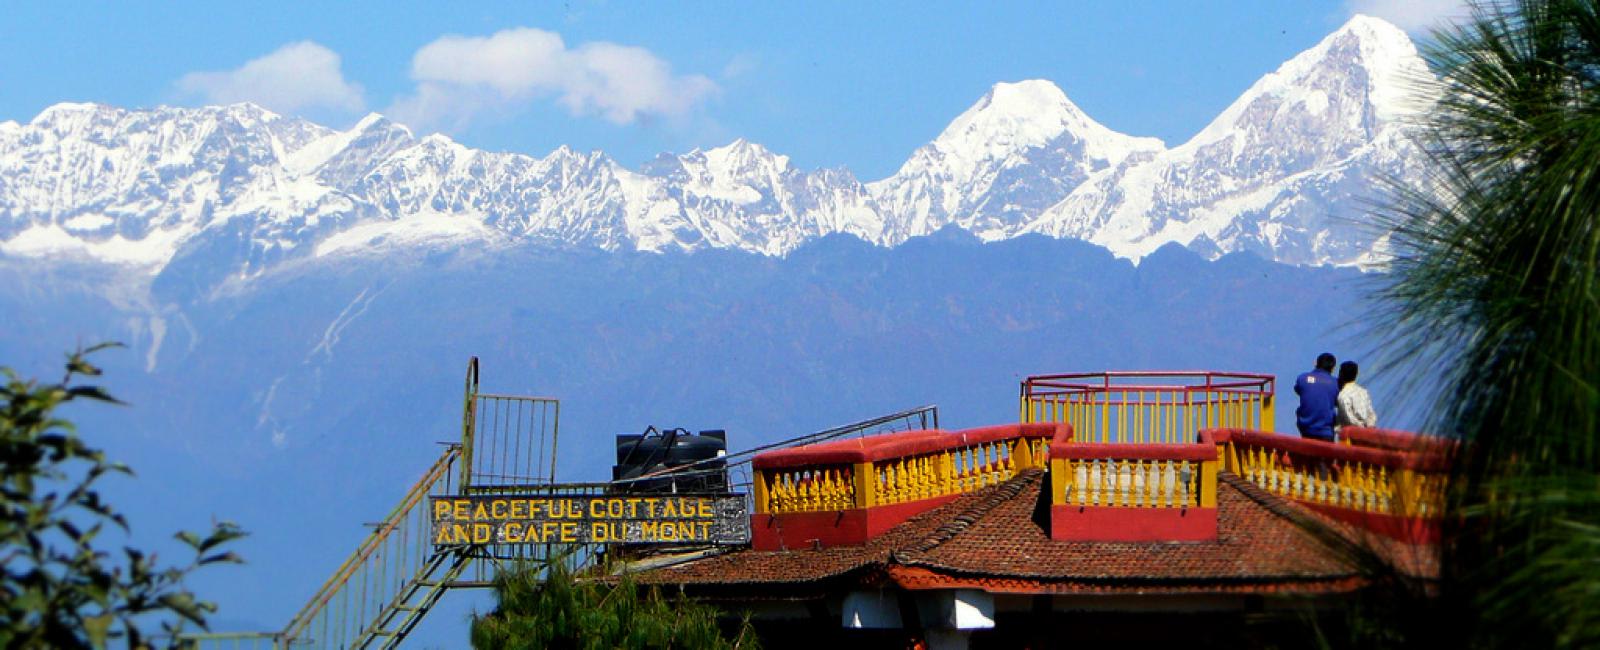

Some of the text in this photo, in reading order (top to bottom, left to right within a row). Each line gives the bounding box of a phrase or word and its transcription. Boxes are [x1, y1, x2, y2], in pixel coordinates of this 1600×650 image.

[435, 498, 714, 520] PEACEFUL COTTAGE
[436, 521, 714, 543] AND CAFE DU MONT
